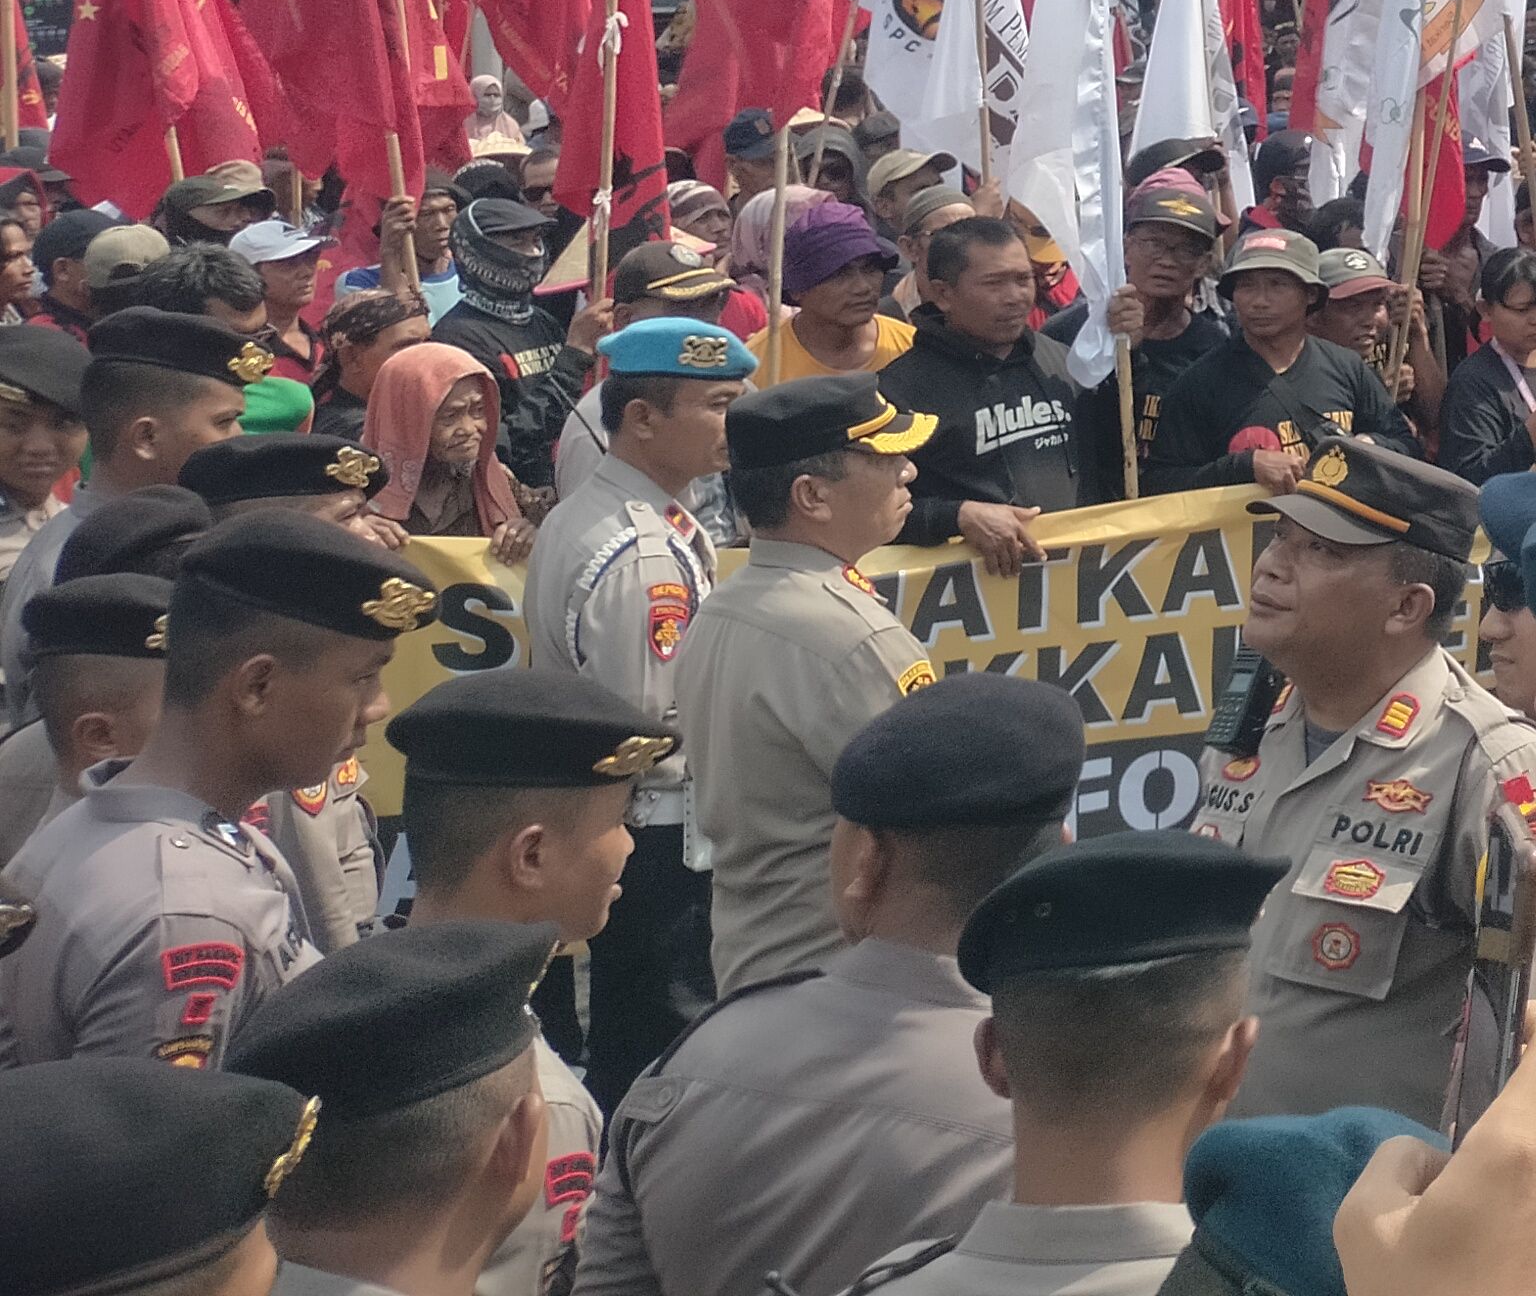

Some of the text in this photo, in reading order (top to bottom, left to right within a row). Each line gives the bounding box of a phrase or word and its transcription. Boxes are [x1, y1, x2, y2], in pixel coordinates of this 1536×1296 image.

[882, 13, 922, 53] SPC
[877, 528, 1262, 649] ATKA
[1331, 813, 1425, 856] POLRI
